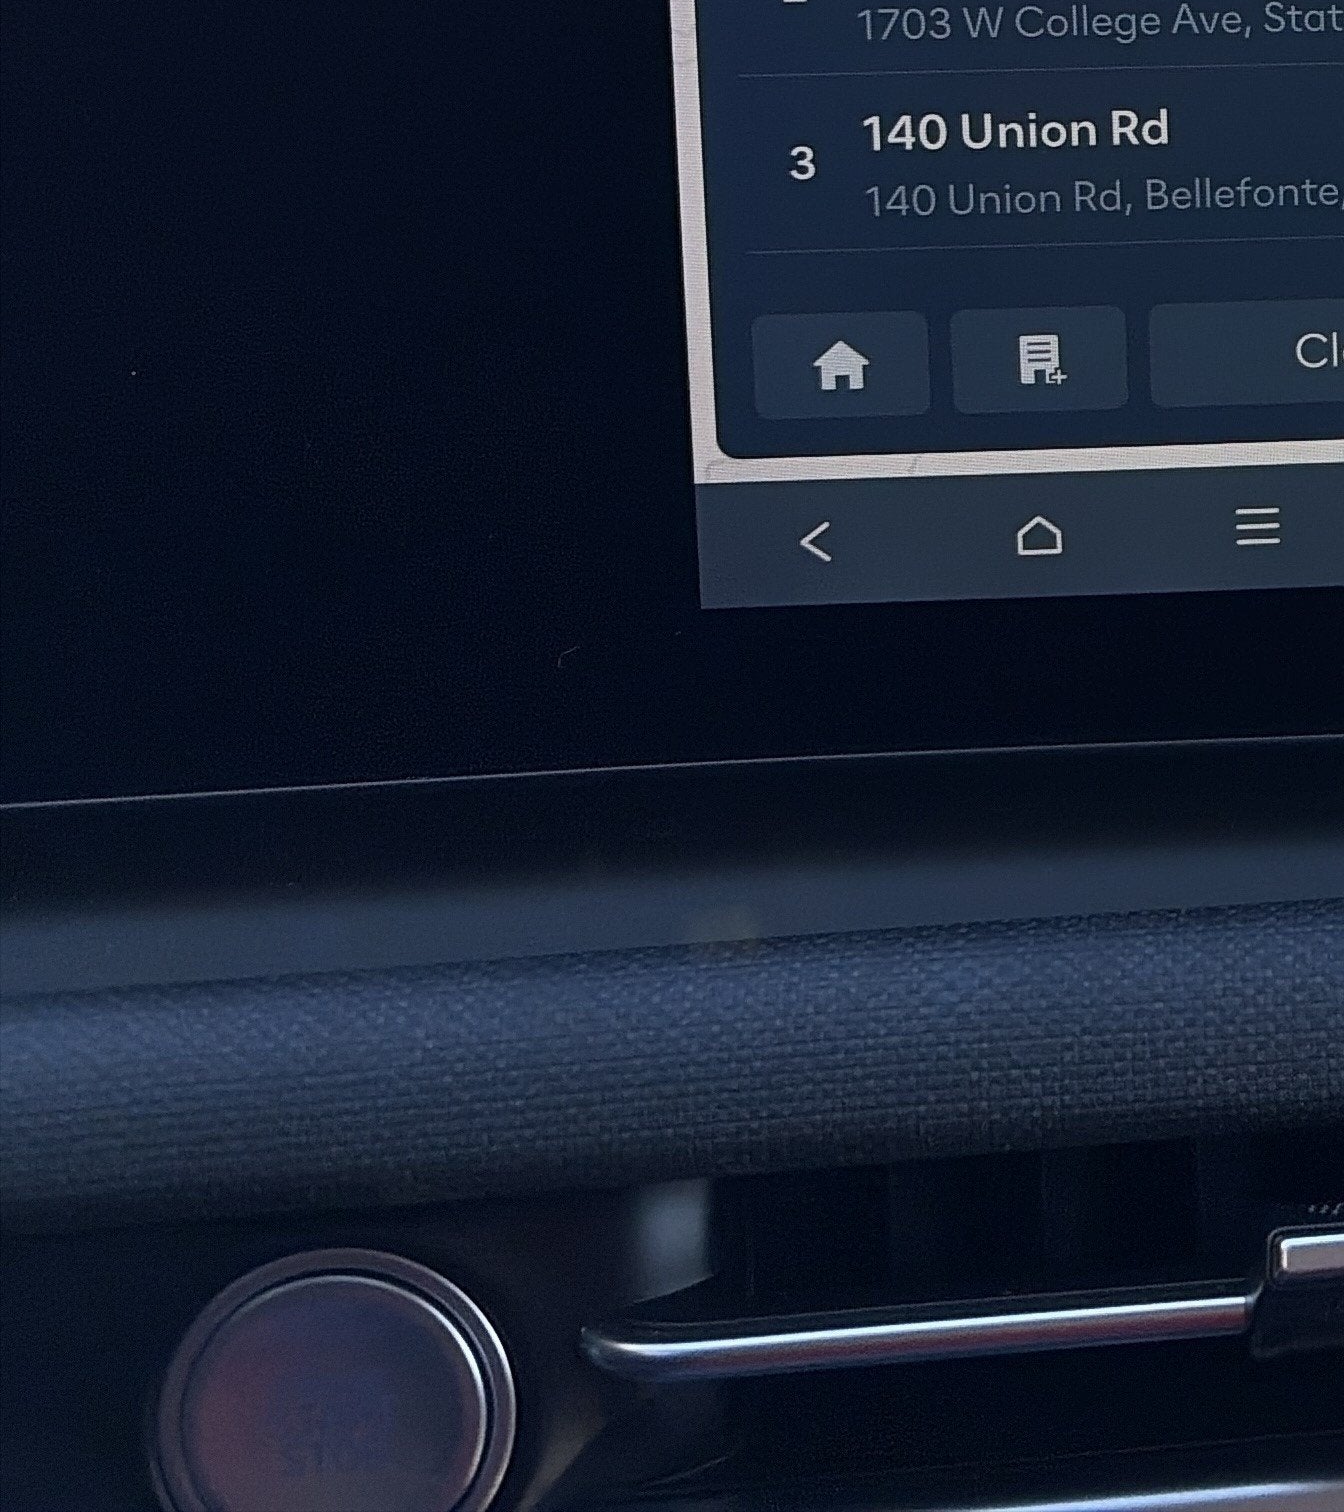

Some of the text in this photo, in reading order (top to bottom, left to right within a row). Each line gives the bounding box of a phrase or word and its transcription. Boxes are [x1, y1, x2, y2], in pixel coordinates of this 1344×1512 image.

[857, 6, 952, 41] 1703
[963, 6, 1005, 38] W
[1015, 3, 1161, 46] College
[1172, 3, 1252, 39] Ave,
[863, 109, 1170, 152] 140 Union Rd
[789, 146, 816, 179] 3
[866, 184, 936, 218] 140
[949, 182, 1062, 215] Union
[1074, 180, 1134, 218] Rd,
